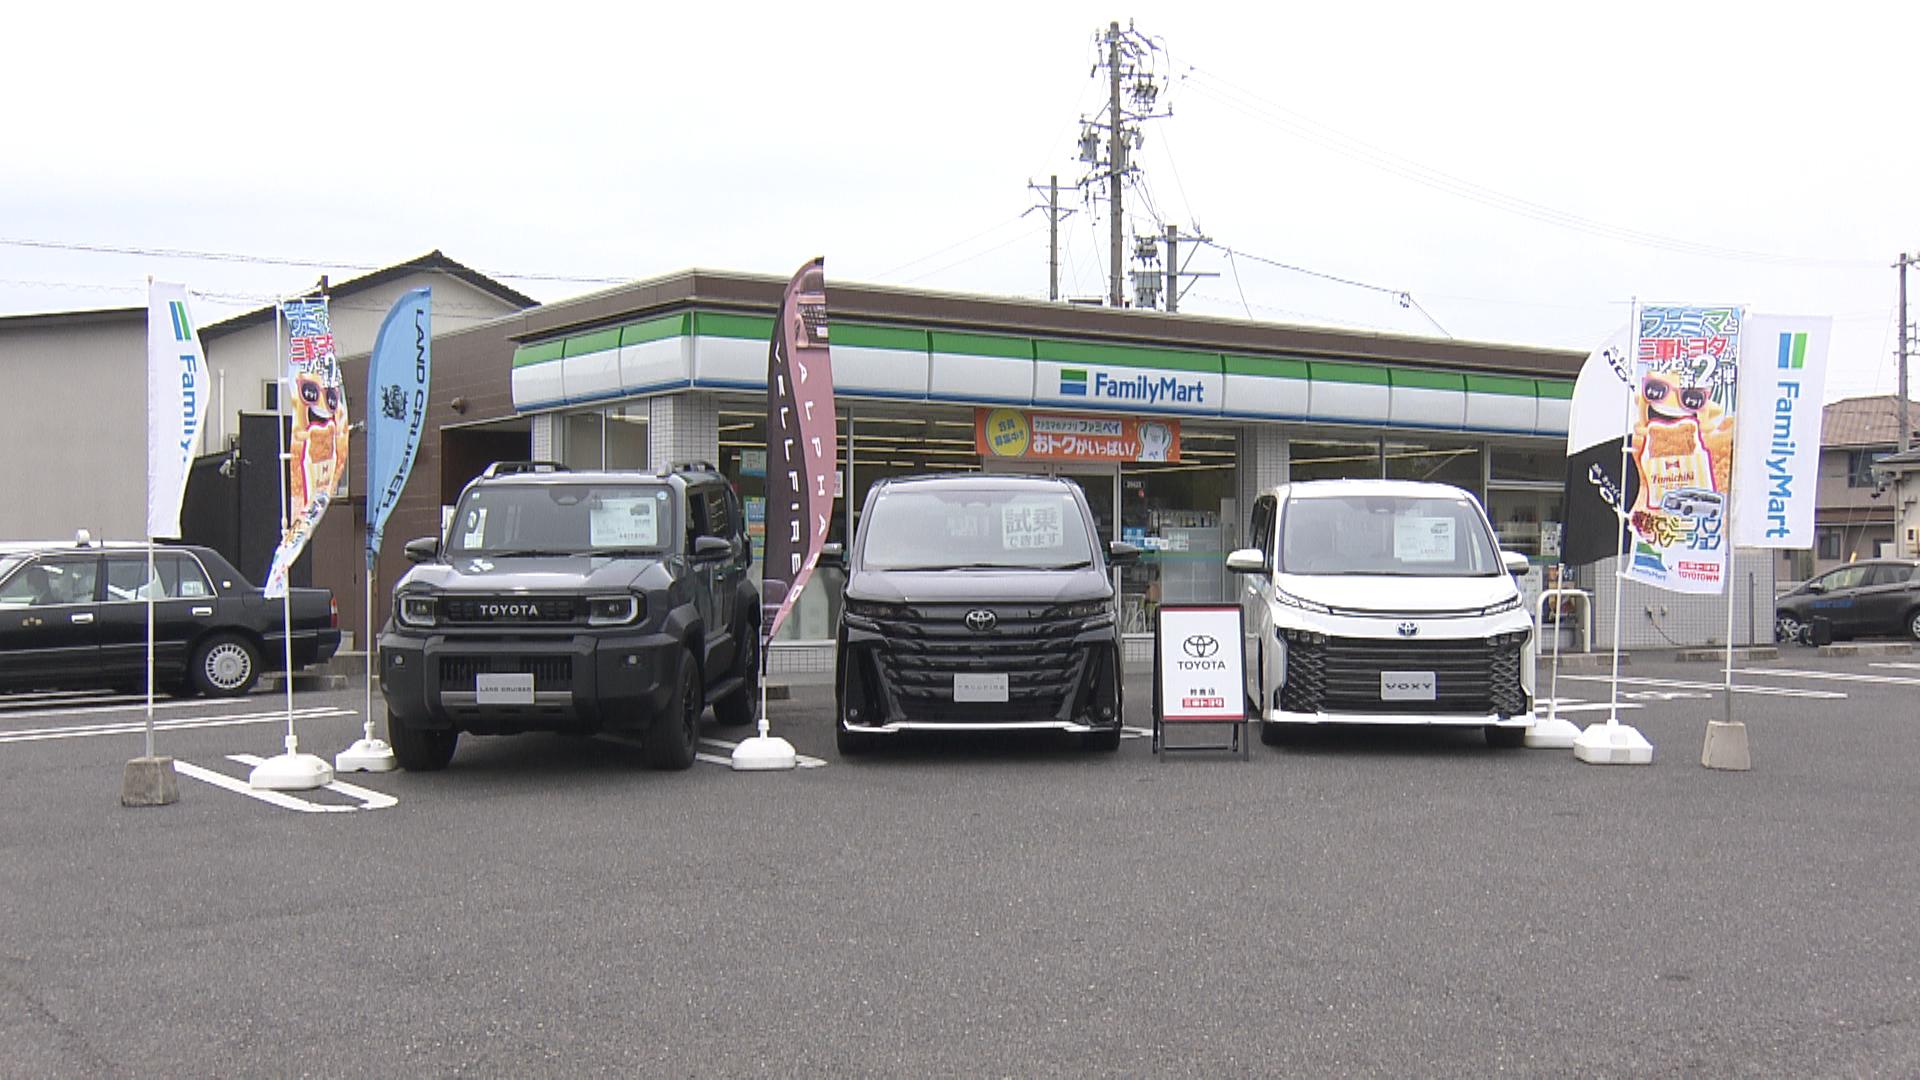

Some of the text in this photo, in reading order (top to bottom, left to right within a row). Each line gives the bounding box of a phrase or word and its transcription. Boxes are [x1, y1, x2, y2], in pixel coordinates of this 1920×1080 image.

[415, 309, 425, 384] LAND
[179, 355, 197, 462] Family
[1095, 372, 1204, 404] FamilyMart
[774, 341, 801, 575] VELLFIRE
[789, 362, 827, 602] ALPHARD
[1766, 381, 1800, 538] FamilyMart
[1006, 507, 1059, 533] 試乗
[480, 604, 538, 616] TOYOTA
[1177, 661, 1226, 670] TOYOTA
[1385, 682, 1432, 690] VOXY
